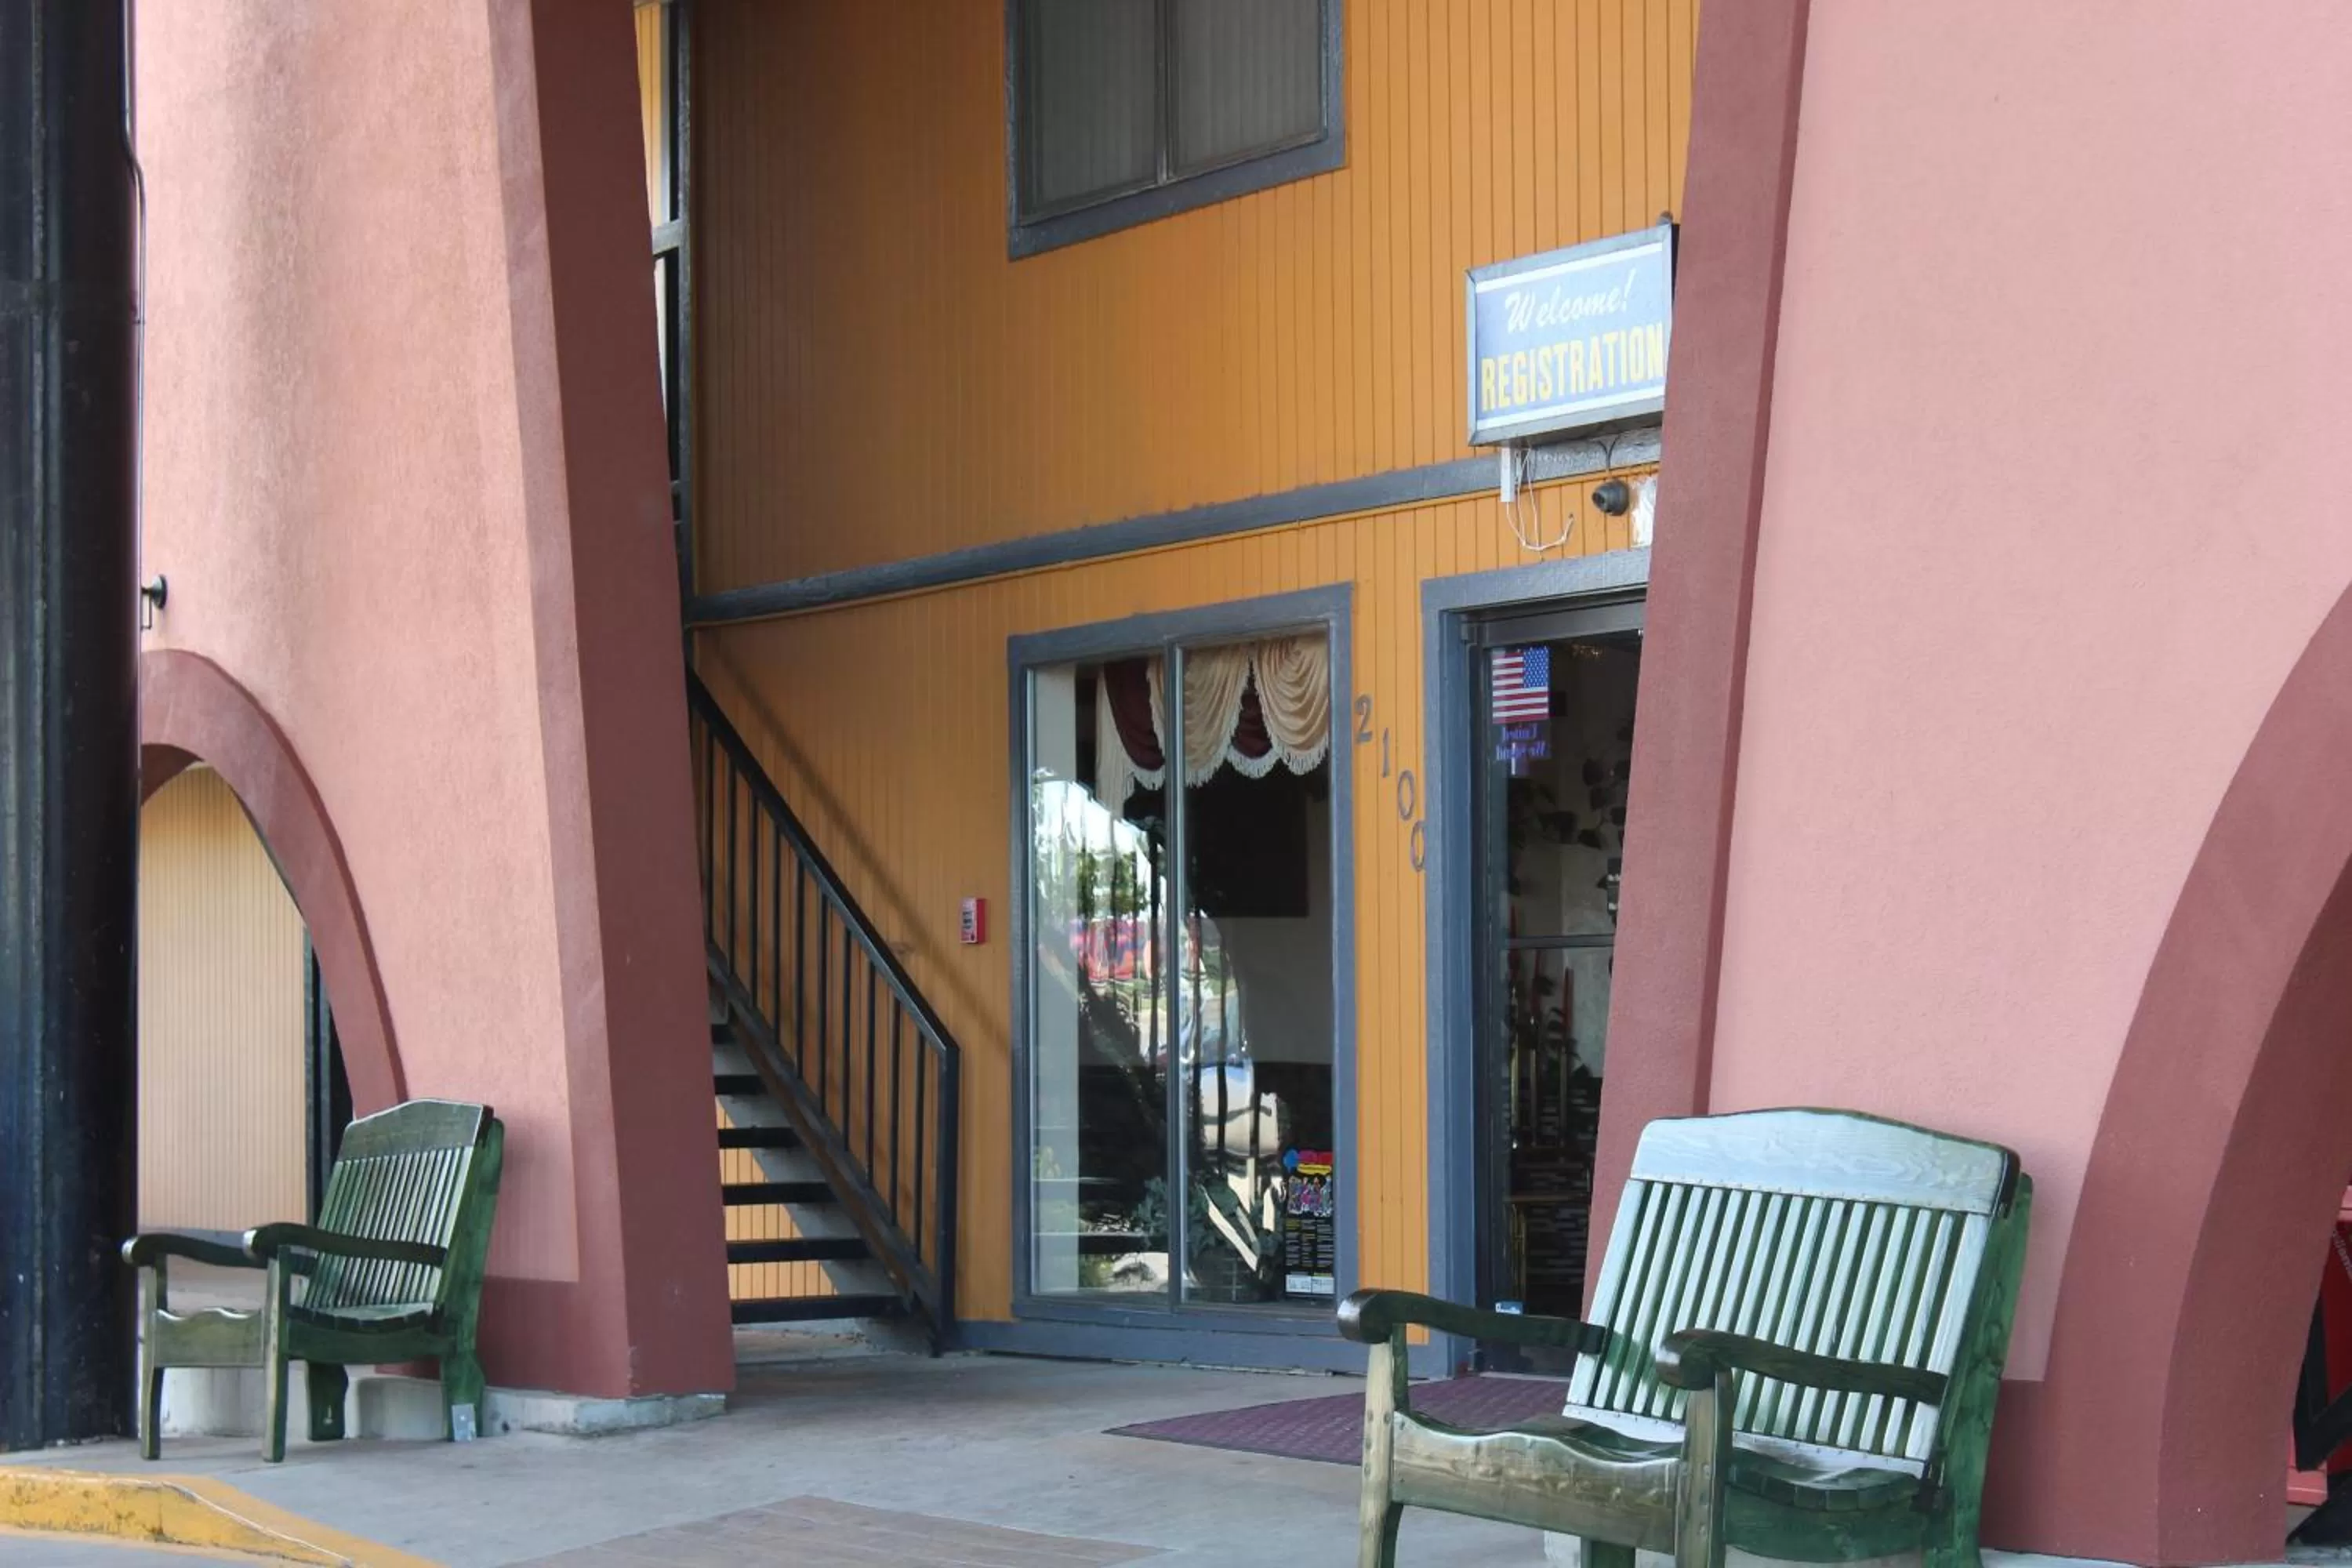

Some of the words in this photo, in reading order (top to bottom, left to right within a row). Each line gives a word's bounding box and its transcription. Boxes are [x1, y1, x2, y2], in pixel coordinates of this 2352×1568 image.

[1504, 267, 1637, 333] Welcome!
[1481, 321, 1664, 412] REGISTRATION
[1355, 694, 1425, 872] 2100
